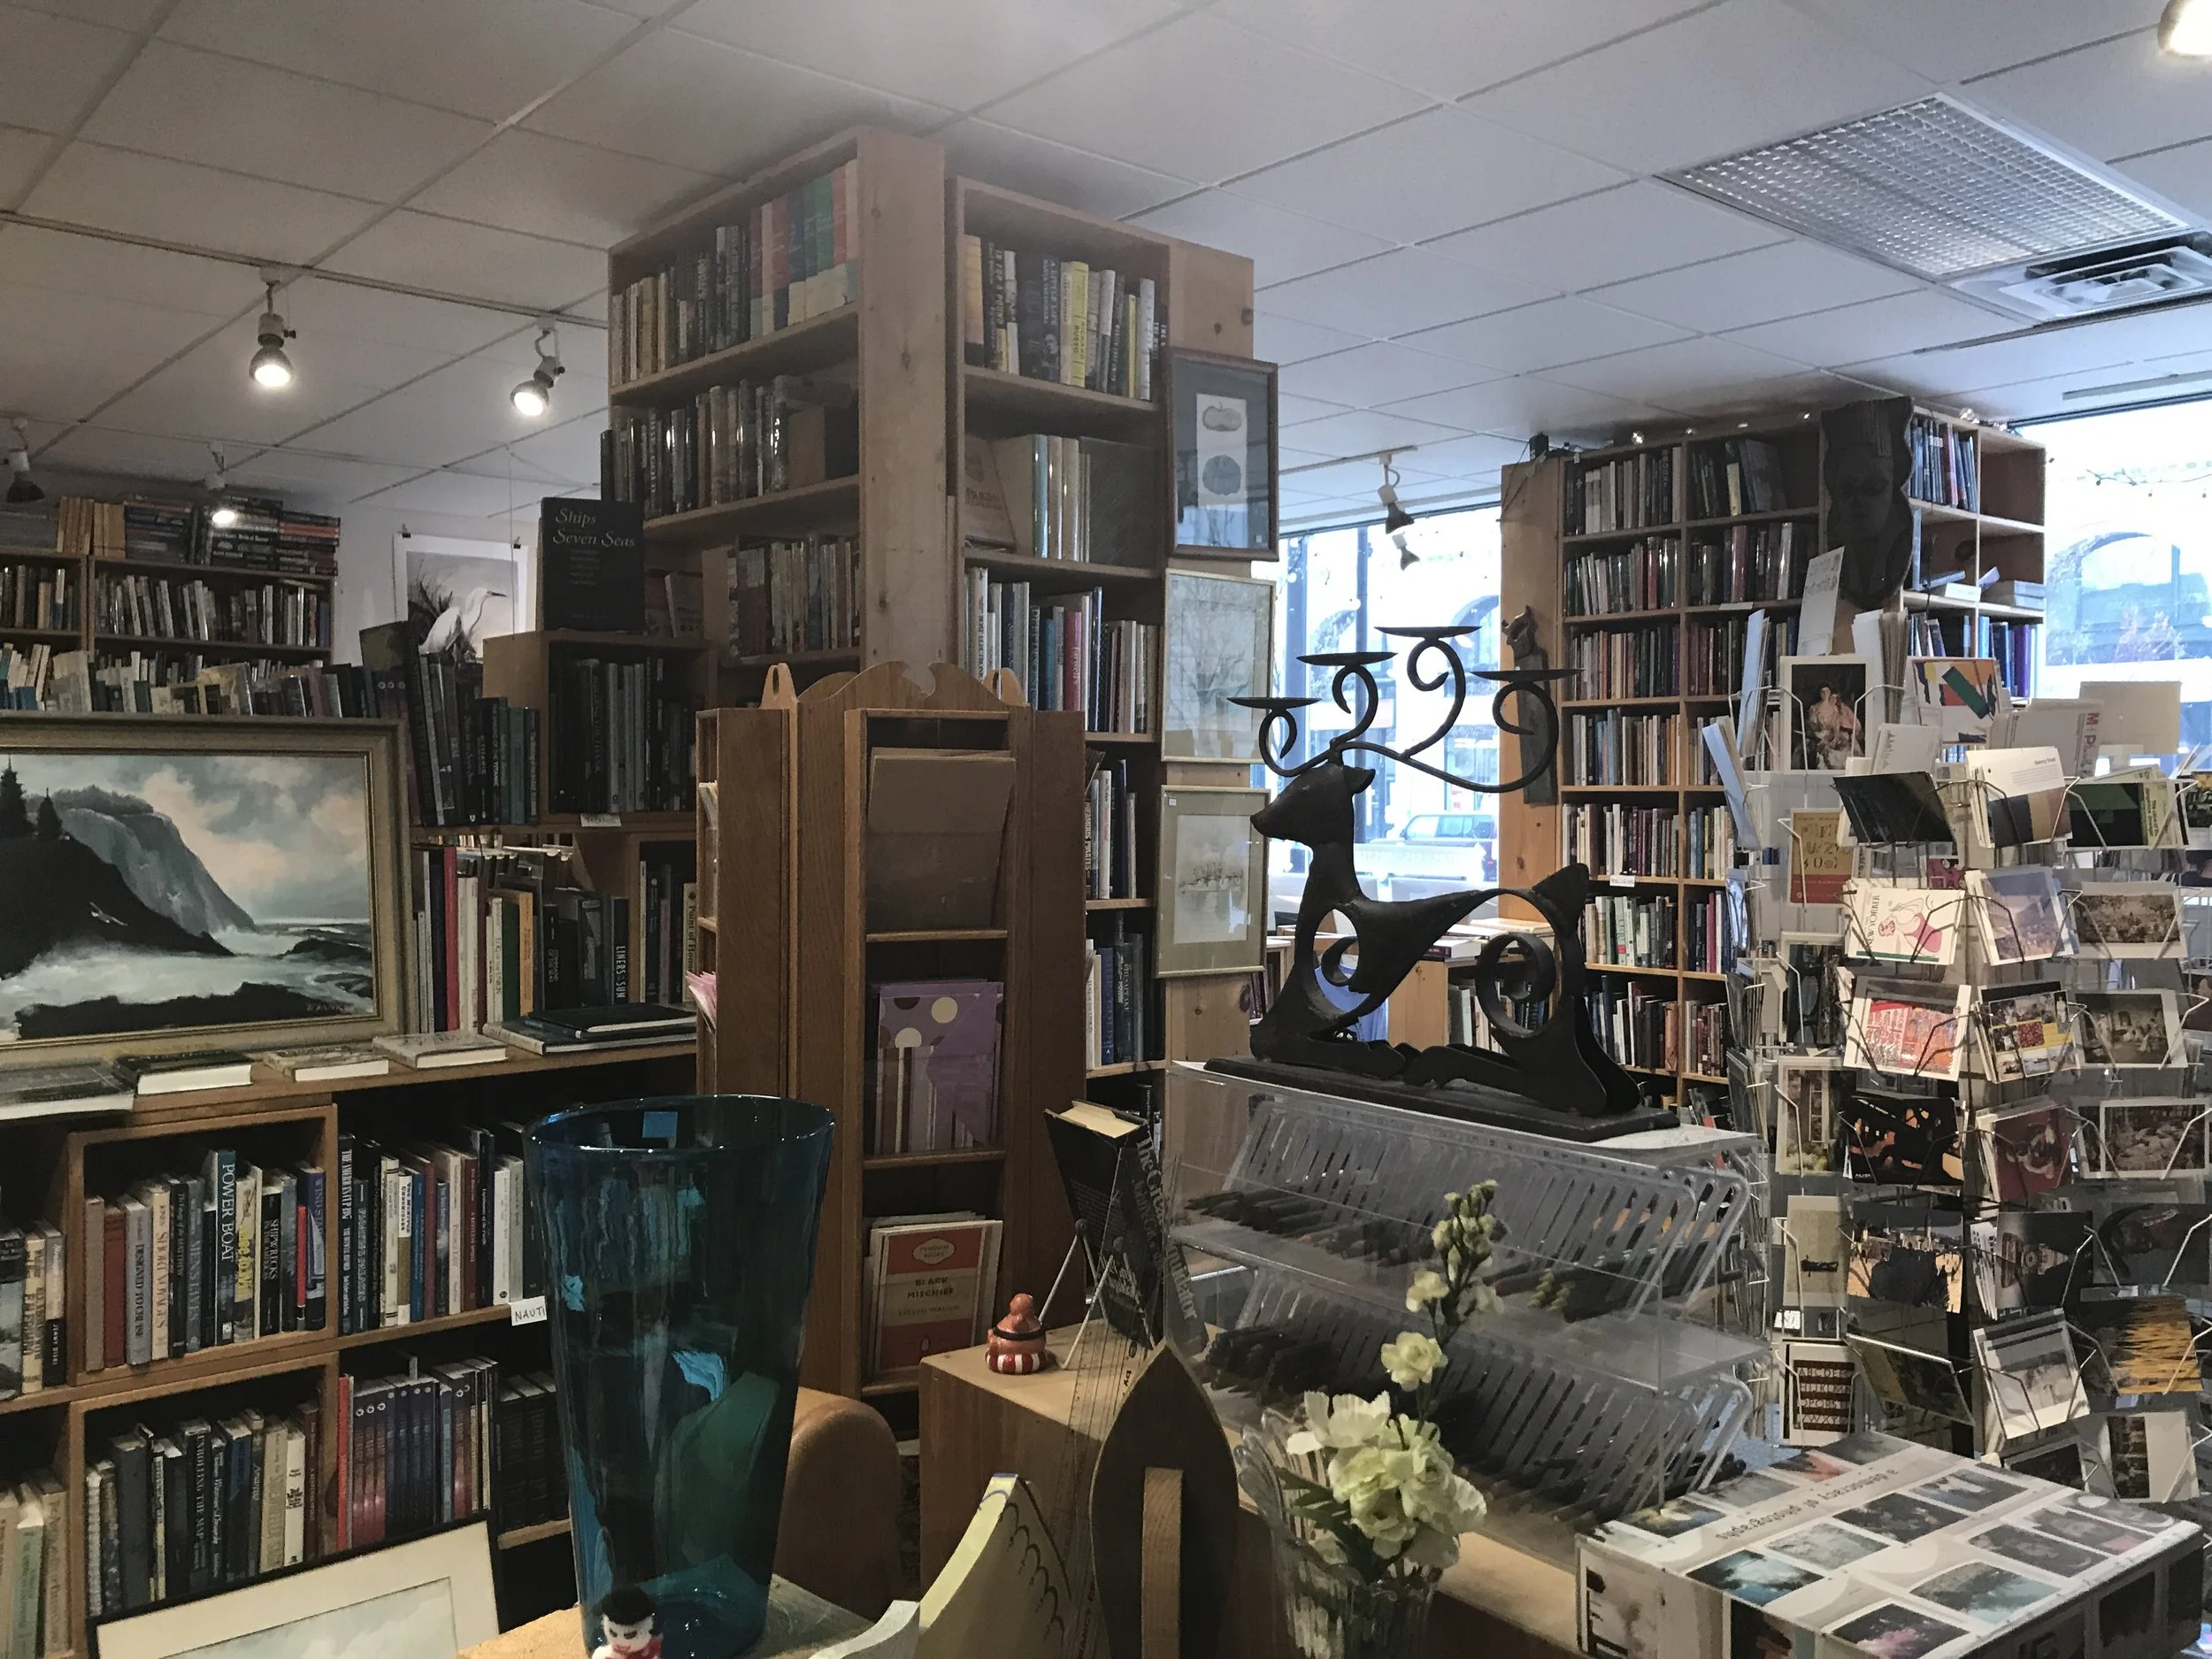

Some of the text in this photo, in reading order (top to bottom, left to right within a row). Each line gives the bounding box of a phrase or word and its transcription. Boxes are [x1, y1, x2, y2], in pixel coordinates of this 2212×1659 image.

[555, 507, 596, 527] Ships
[552, 528, 635, 547] Seven Seas
[688, 932, 696, 941] of
[616, 945, 626, 998] LINERS SUN
[342, 1149, 352, 1162] THE
[1137, 1136, 1153, 1170] The
[315, 1178, 324, 1206] WIND
[221, 1164, 235, 1262] POWER BOAT
[269, 1218, 279, 1280] SHIPWRECKS
[135, 1244, 144, 1340] DESIGNED TO CRUISE
[156, 1232, 168, 1329] SHORT VOYAGES
[188, 1240, 200, 1323] MEN'S LIVES
[907, 1287, 954, 1298] MISCHIEF
[915, 1277, 949, 1286] BLACK
[196, 1435, 205, 1492] UNROLLING
[1818, 1472, 1887, 1500] democracy
[196, 1494, 205, 1515] THE
[1803, 1499, 1819, 1509] of
[196, 1517, 205, 1539] MAP
